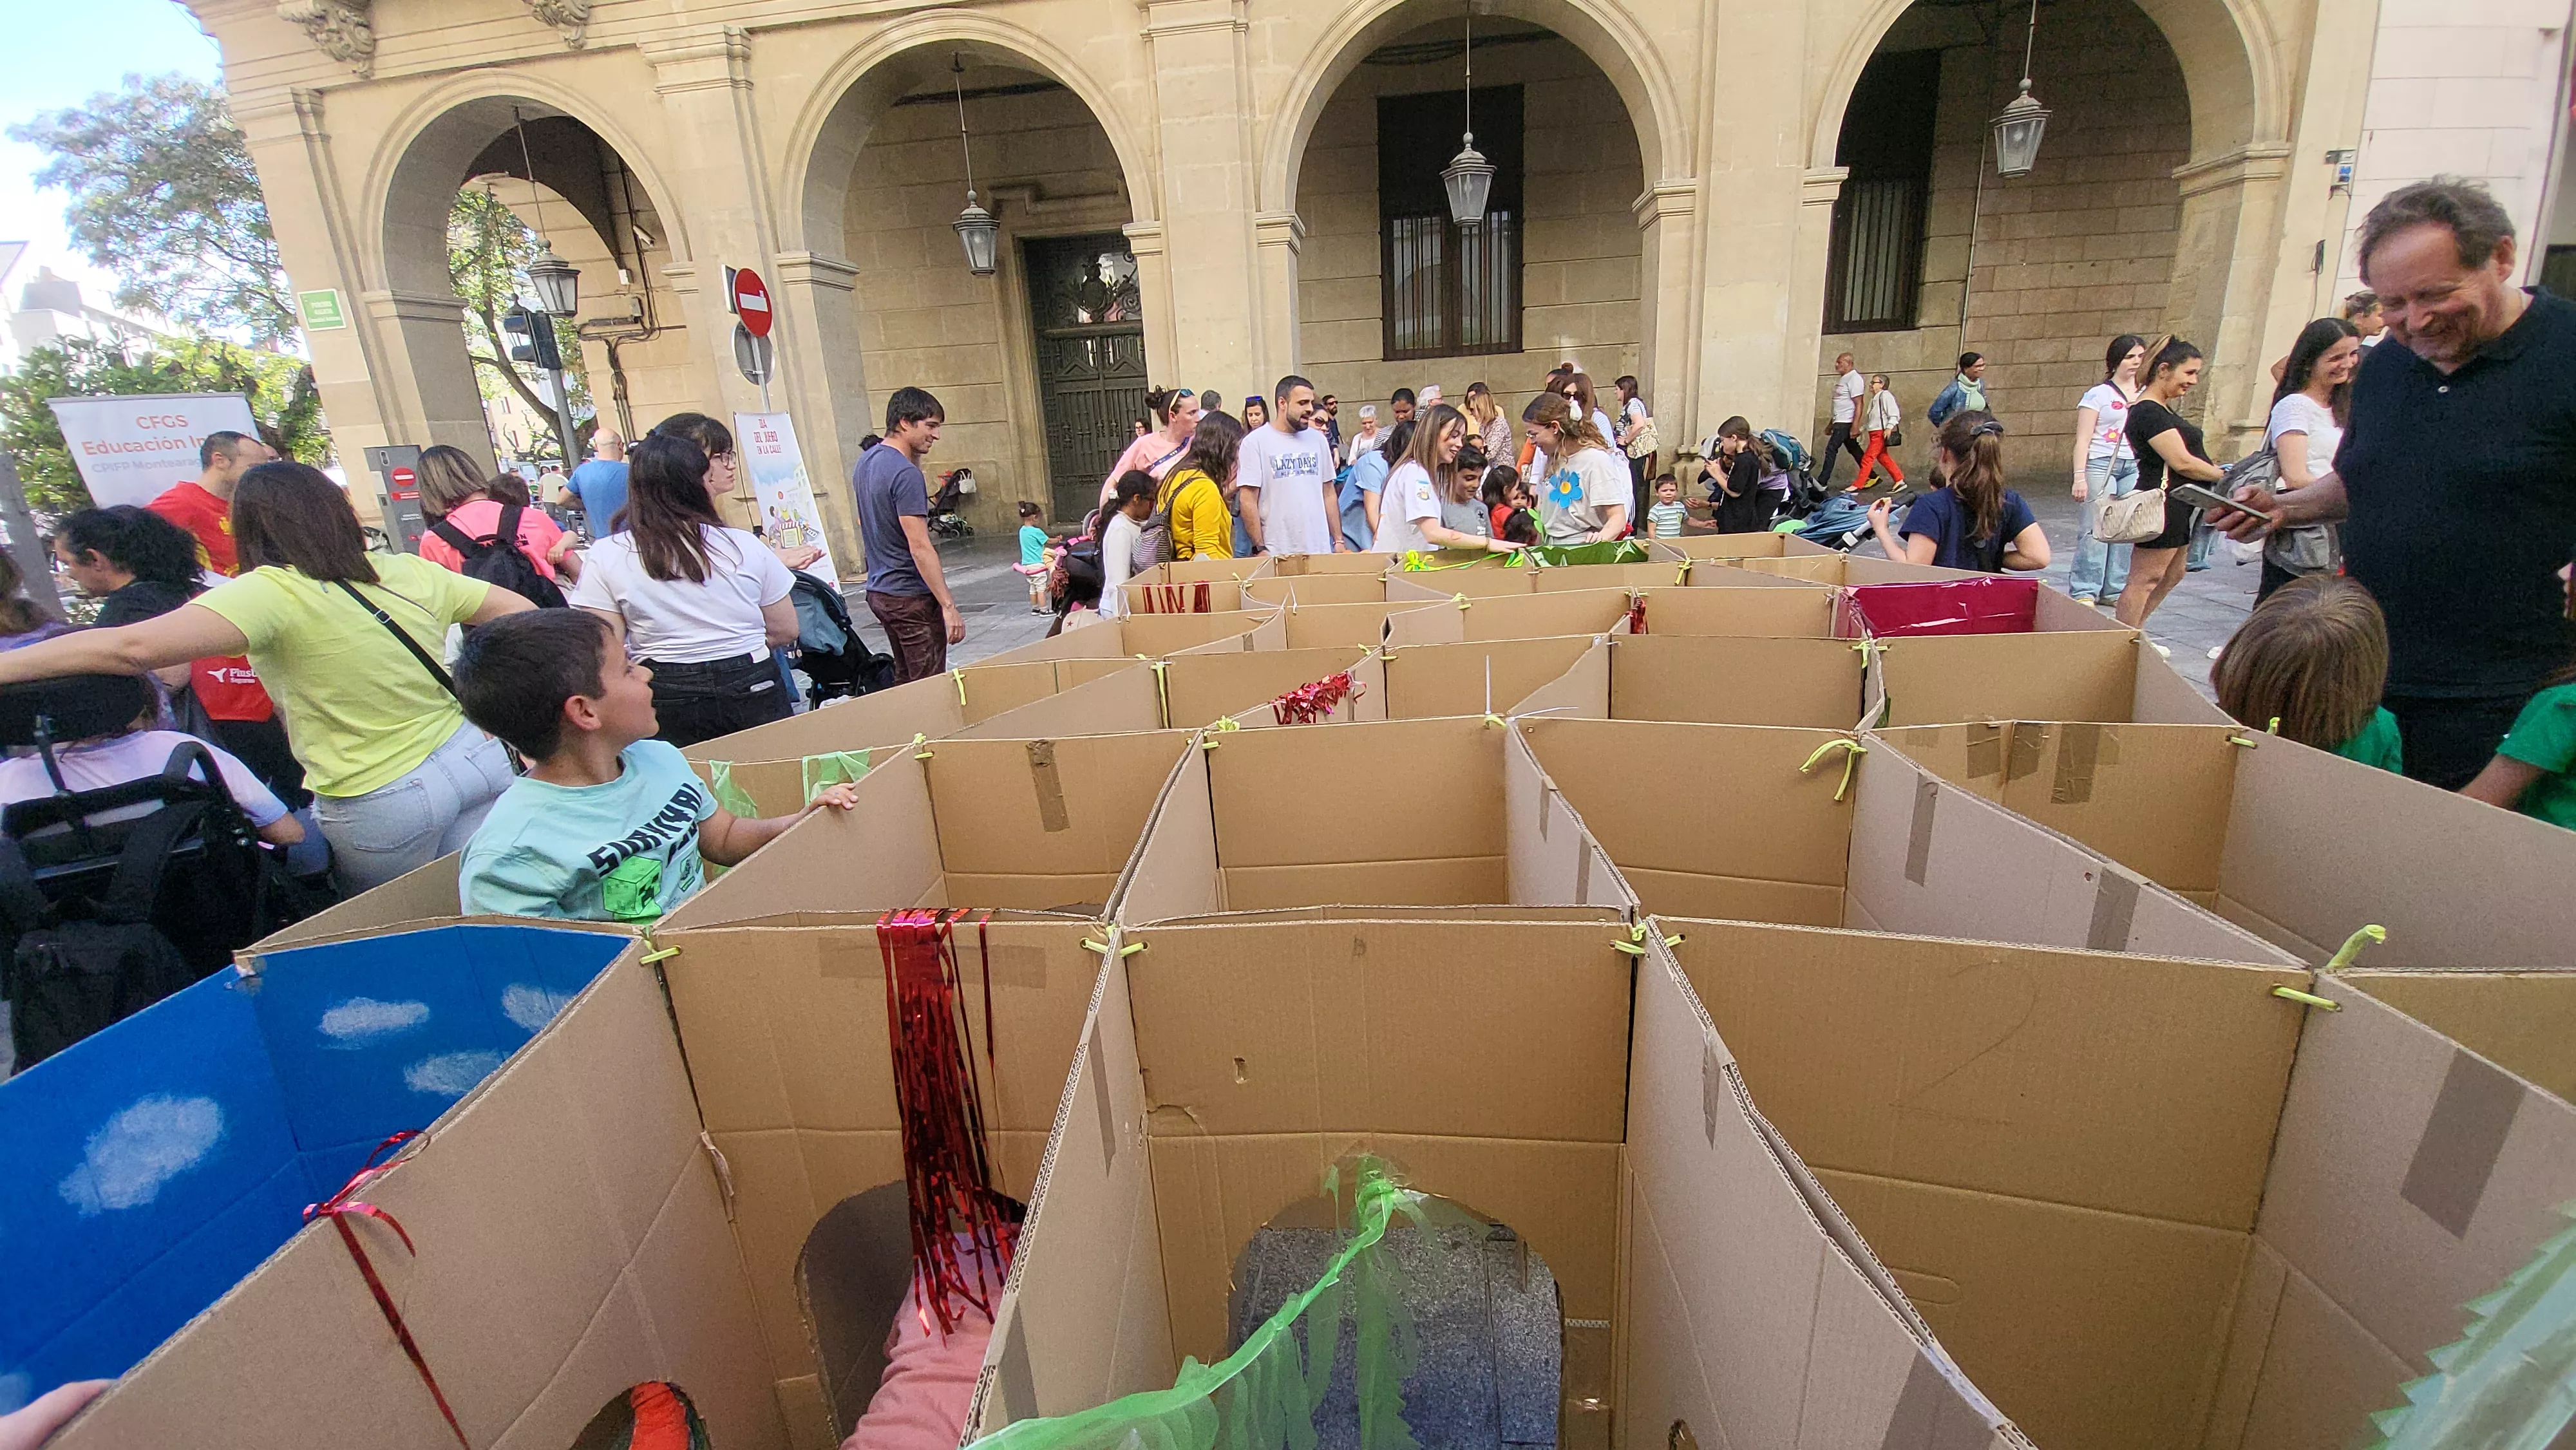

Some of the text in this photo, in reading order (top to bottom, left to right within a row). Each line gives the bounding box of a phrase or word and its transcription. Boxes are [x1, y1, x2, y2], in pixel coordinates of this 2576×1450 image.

[136, 414, 189, 430] CFGS
[81, 437, 187, 455] Educación
[132, 457, 202, 472] Montearag
[1274, 456, 1316, 471] LAZY DAYS
